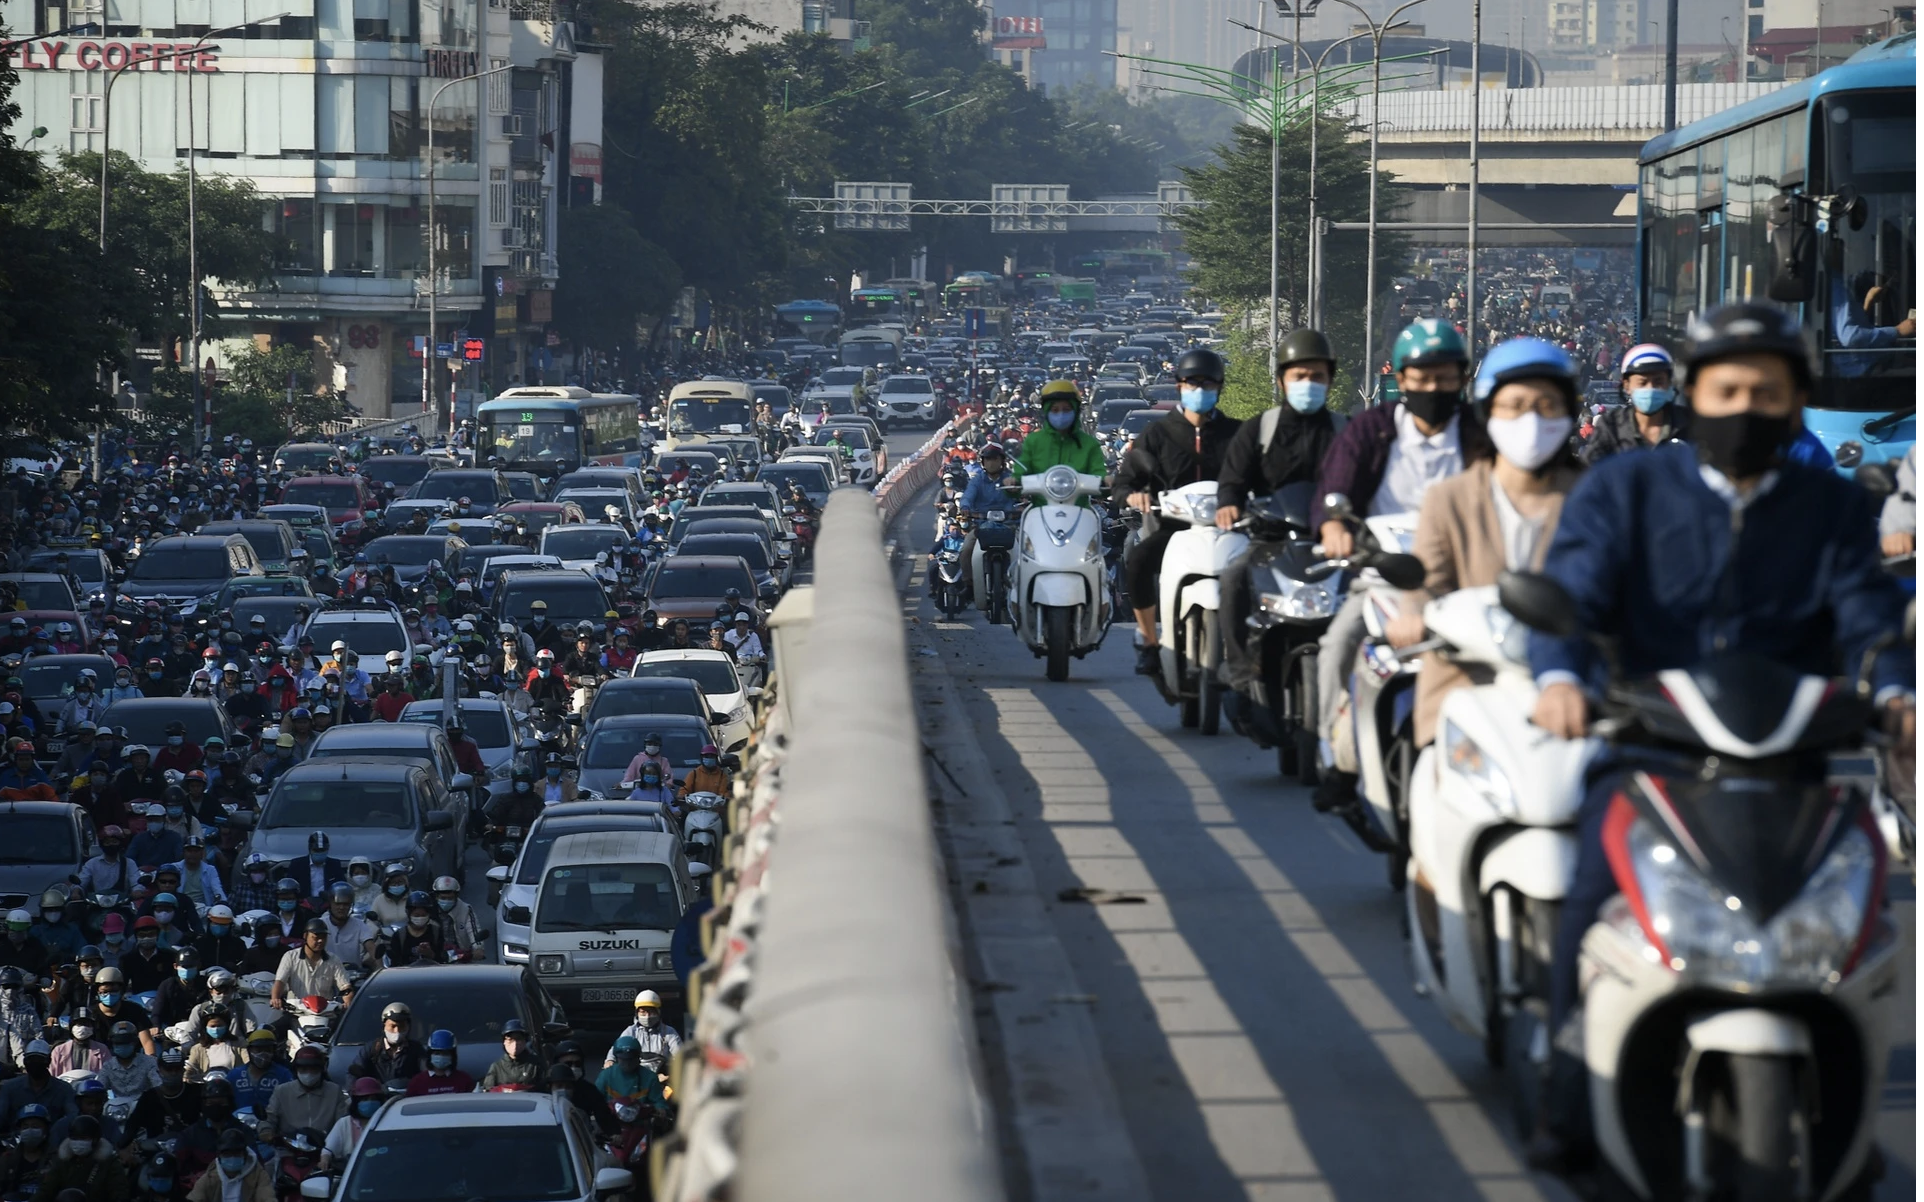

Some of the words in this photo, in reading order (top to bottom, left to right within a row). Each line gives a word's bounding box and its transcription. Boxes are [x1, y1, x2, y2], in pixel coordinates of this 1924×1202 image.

[77, 41, 219, 72] COFFEE
[348, 324, 380, 349] 93
[520, 427, 531, 436] 19
[579, 939, 640, 950] SUZUKI
[583, 989, 636, 1001] 29D-065.68
